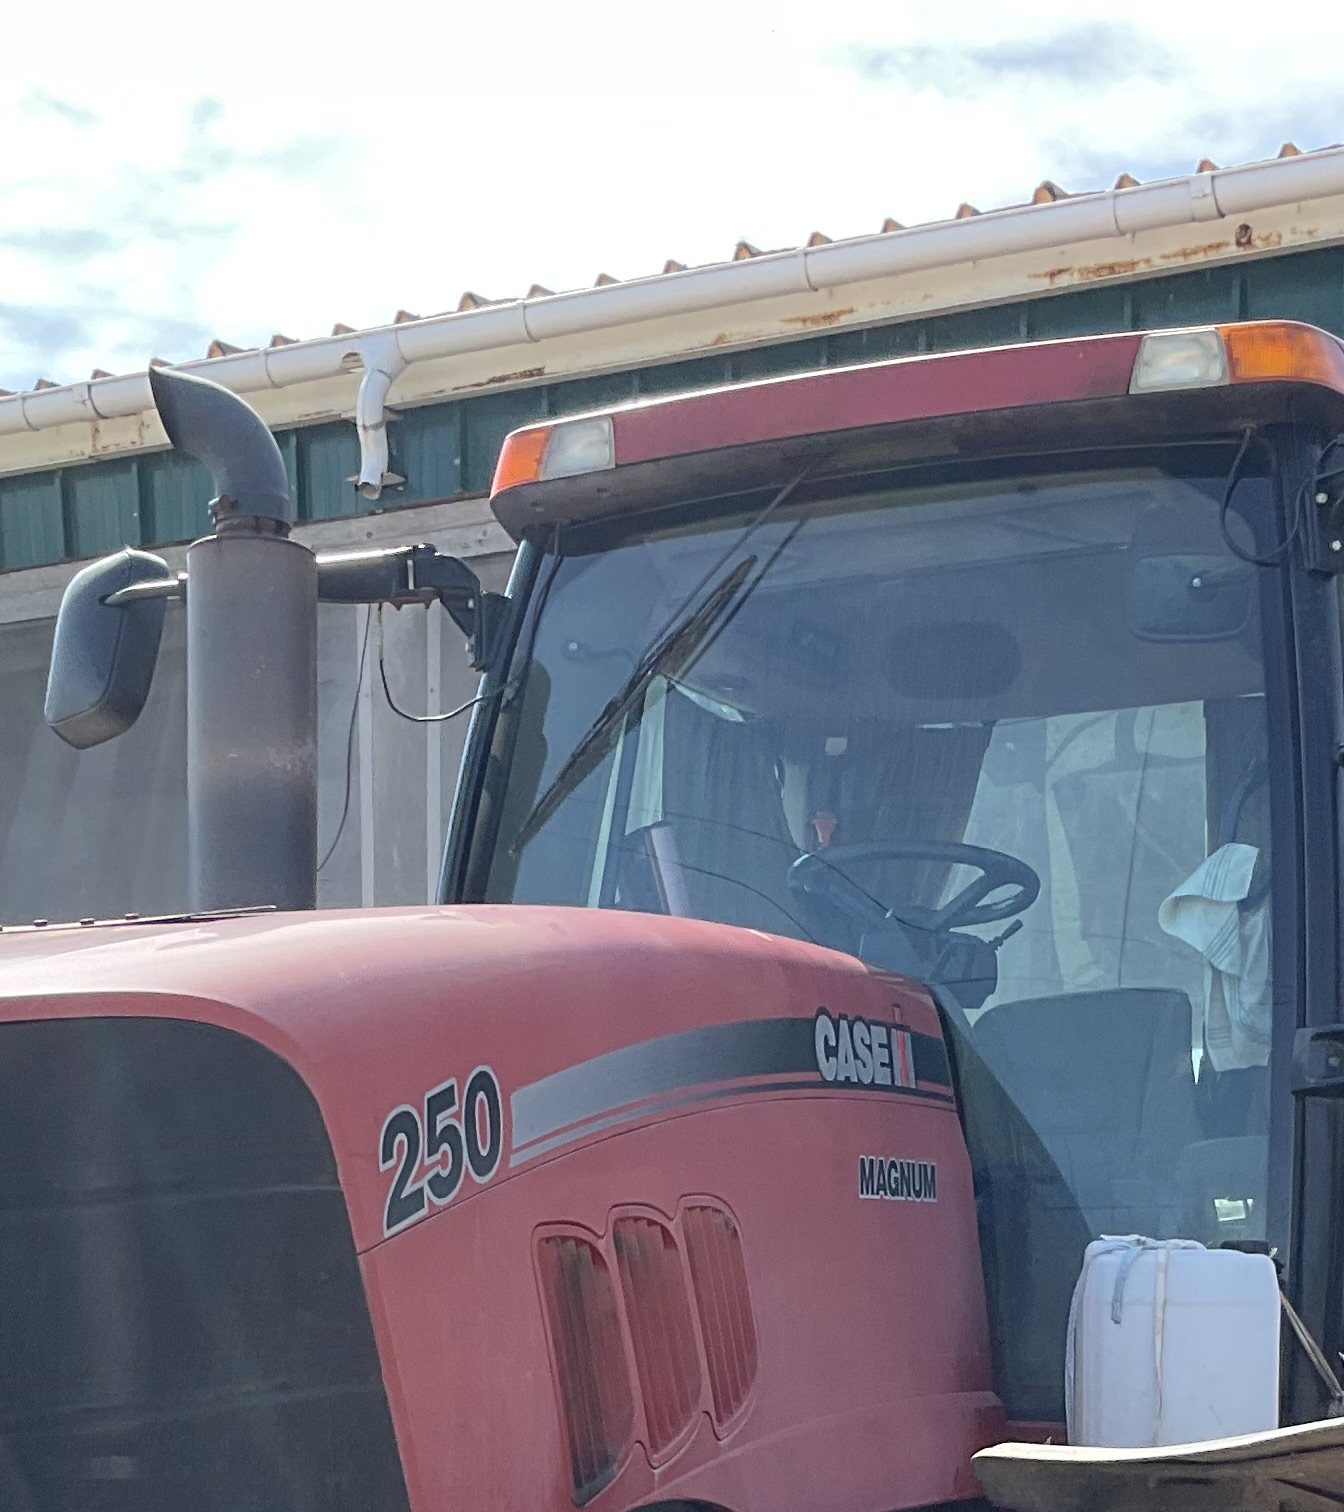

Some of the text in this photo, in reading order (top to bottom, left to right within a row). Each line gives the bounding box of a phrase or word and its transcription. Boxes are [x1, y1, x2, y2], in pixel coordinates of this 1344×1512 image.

[814, 1013, 892, 1086] CASE
[378, 1064, 504, 1239] 250
[858, 1154, 938, 1202] MAGNUM
